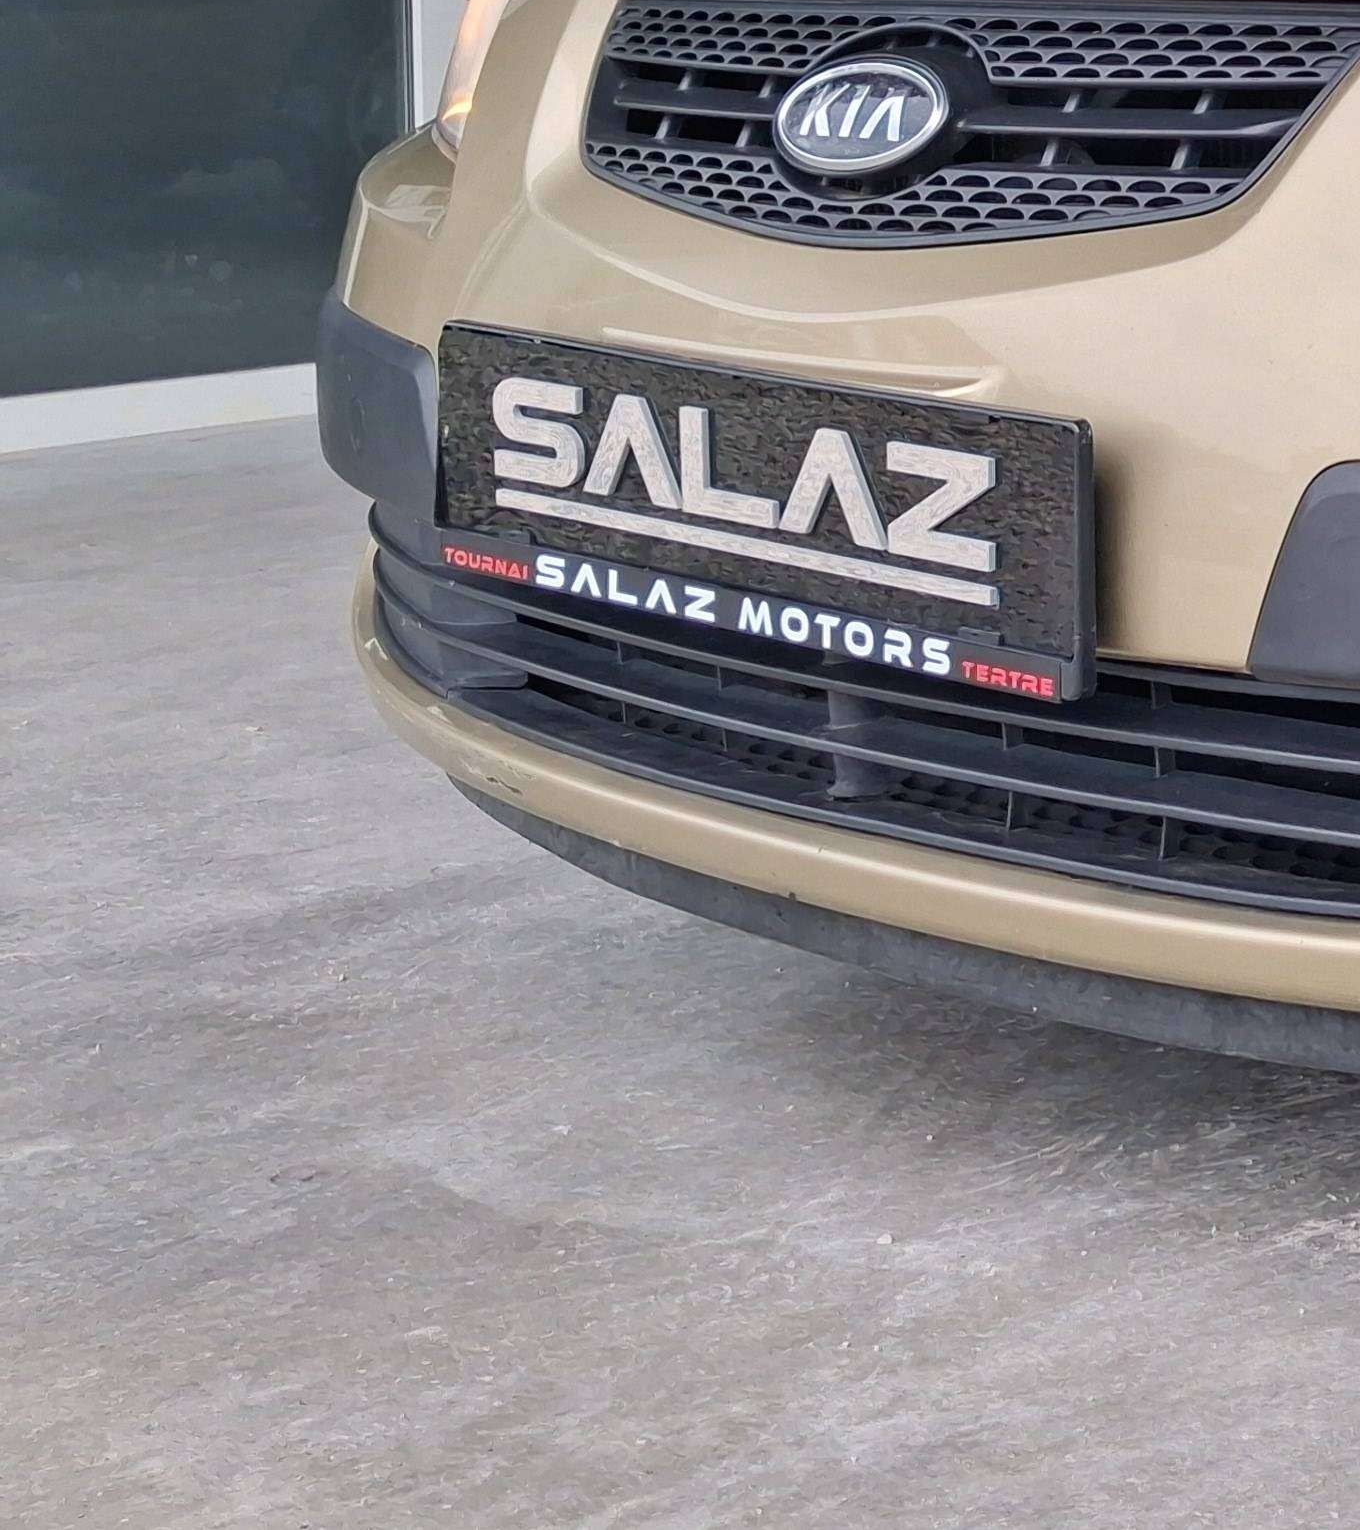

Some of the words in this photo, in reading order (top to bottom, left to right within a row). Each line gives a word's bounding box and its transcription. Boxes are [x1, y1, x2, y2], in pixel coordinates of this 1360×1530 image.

[799, 83, 906, 142] KIA
[492, 376, 997, 573] SALAZ
[444, 547, 529, 580] TOURNAI
[535, 554, 716, 624] SALAZ
[738, 597, 951, 676] MOTORS
[961, 660, 1054, 697] TERTRE
